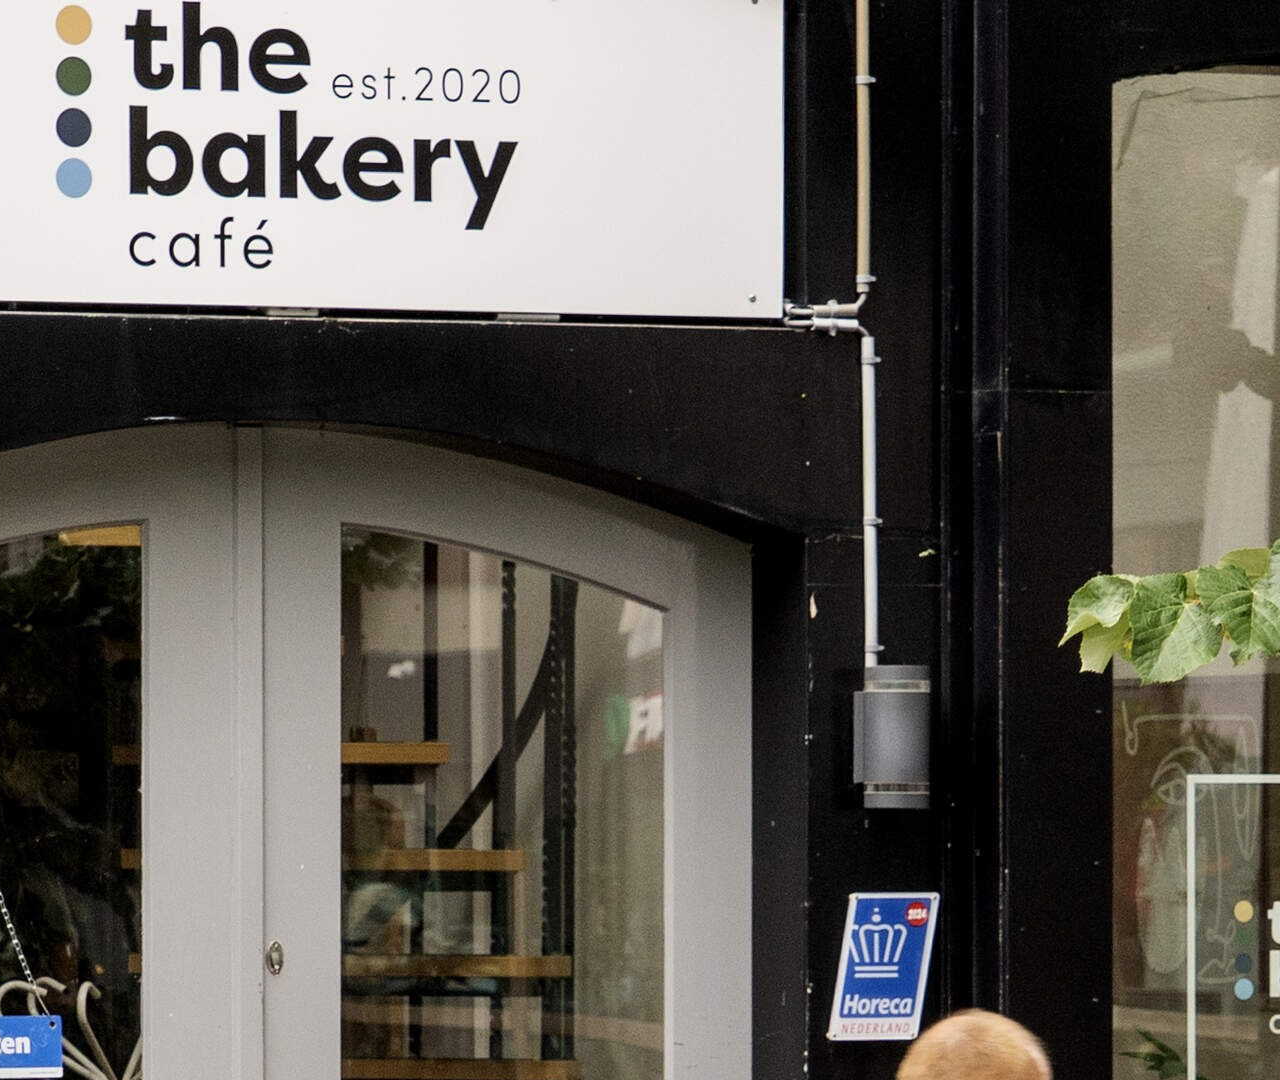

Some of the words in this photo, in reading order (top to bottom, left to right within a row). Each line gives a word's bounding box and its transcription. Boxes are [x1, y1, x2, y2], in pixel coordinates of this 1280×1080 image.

[124, 1, 311, 93] the
[331, 66, 522, 105] est.2020
[129, 105, 519, 231] bakery
[129, 216, 275, 270] café
[841, 1022, 910, 1034] NEDERLAND
[842, 993, 913, 1016] Horeca
